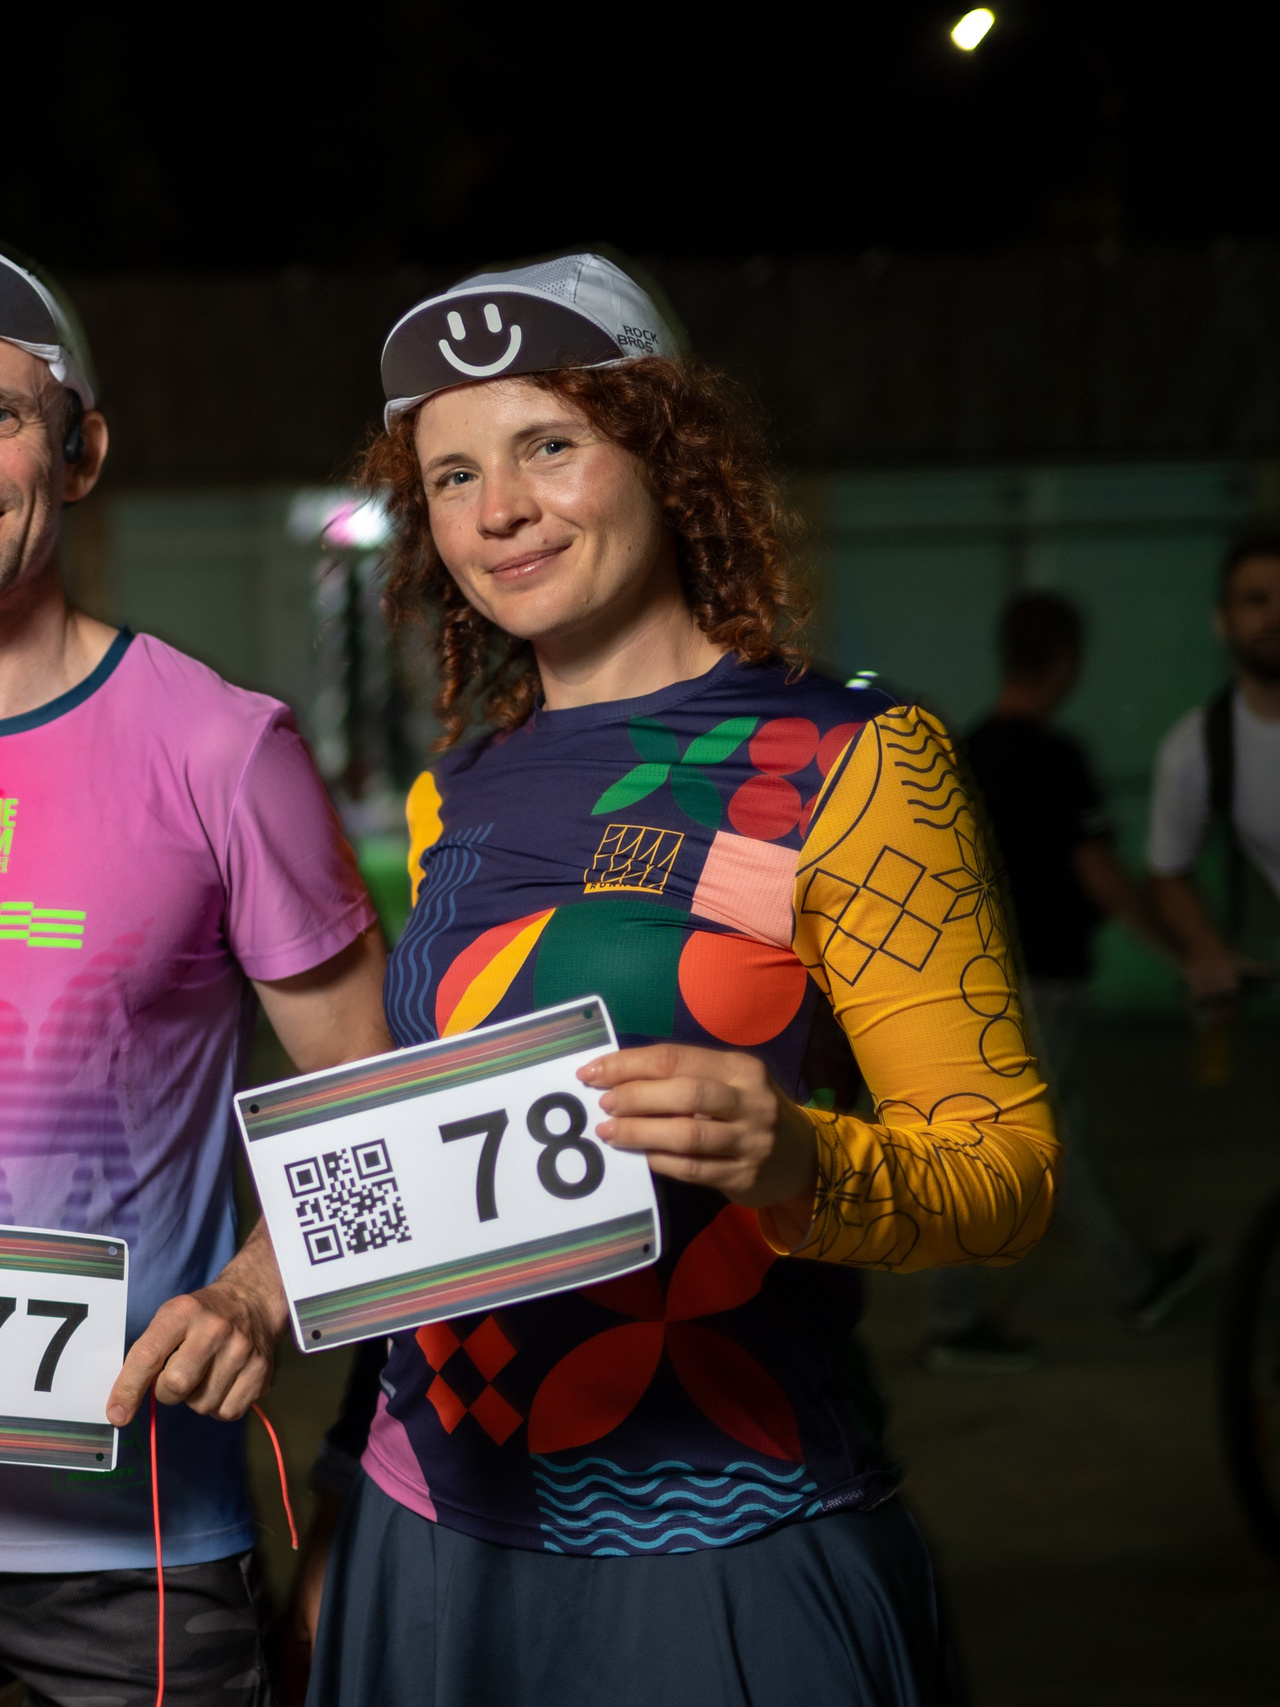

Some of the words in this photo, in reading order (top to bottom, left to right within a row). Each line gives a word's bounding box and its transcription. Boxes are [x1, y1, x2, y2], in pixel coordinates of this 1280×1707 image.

[616, 334, 654, 354] BROS
[622, 324, 660, 345] ROCK
[437, 1091, 606, 1223] 78
